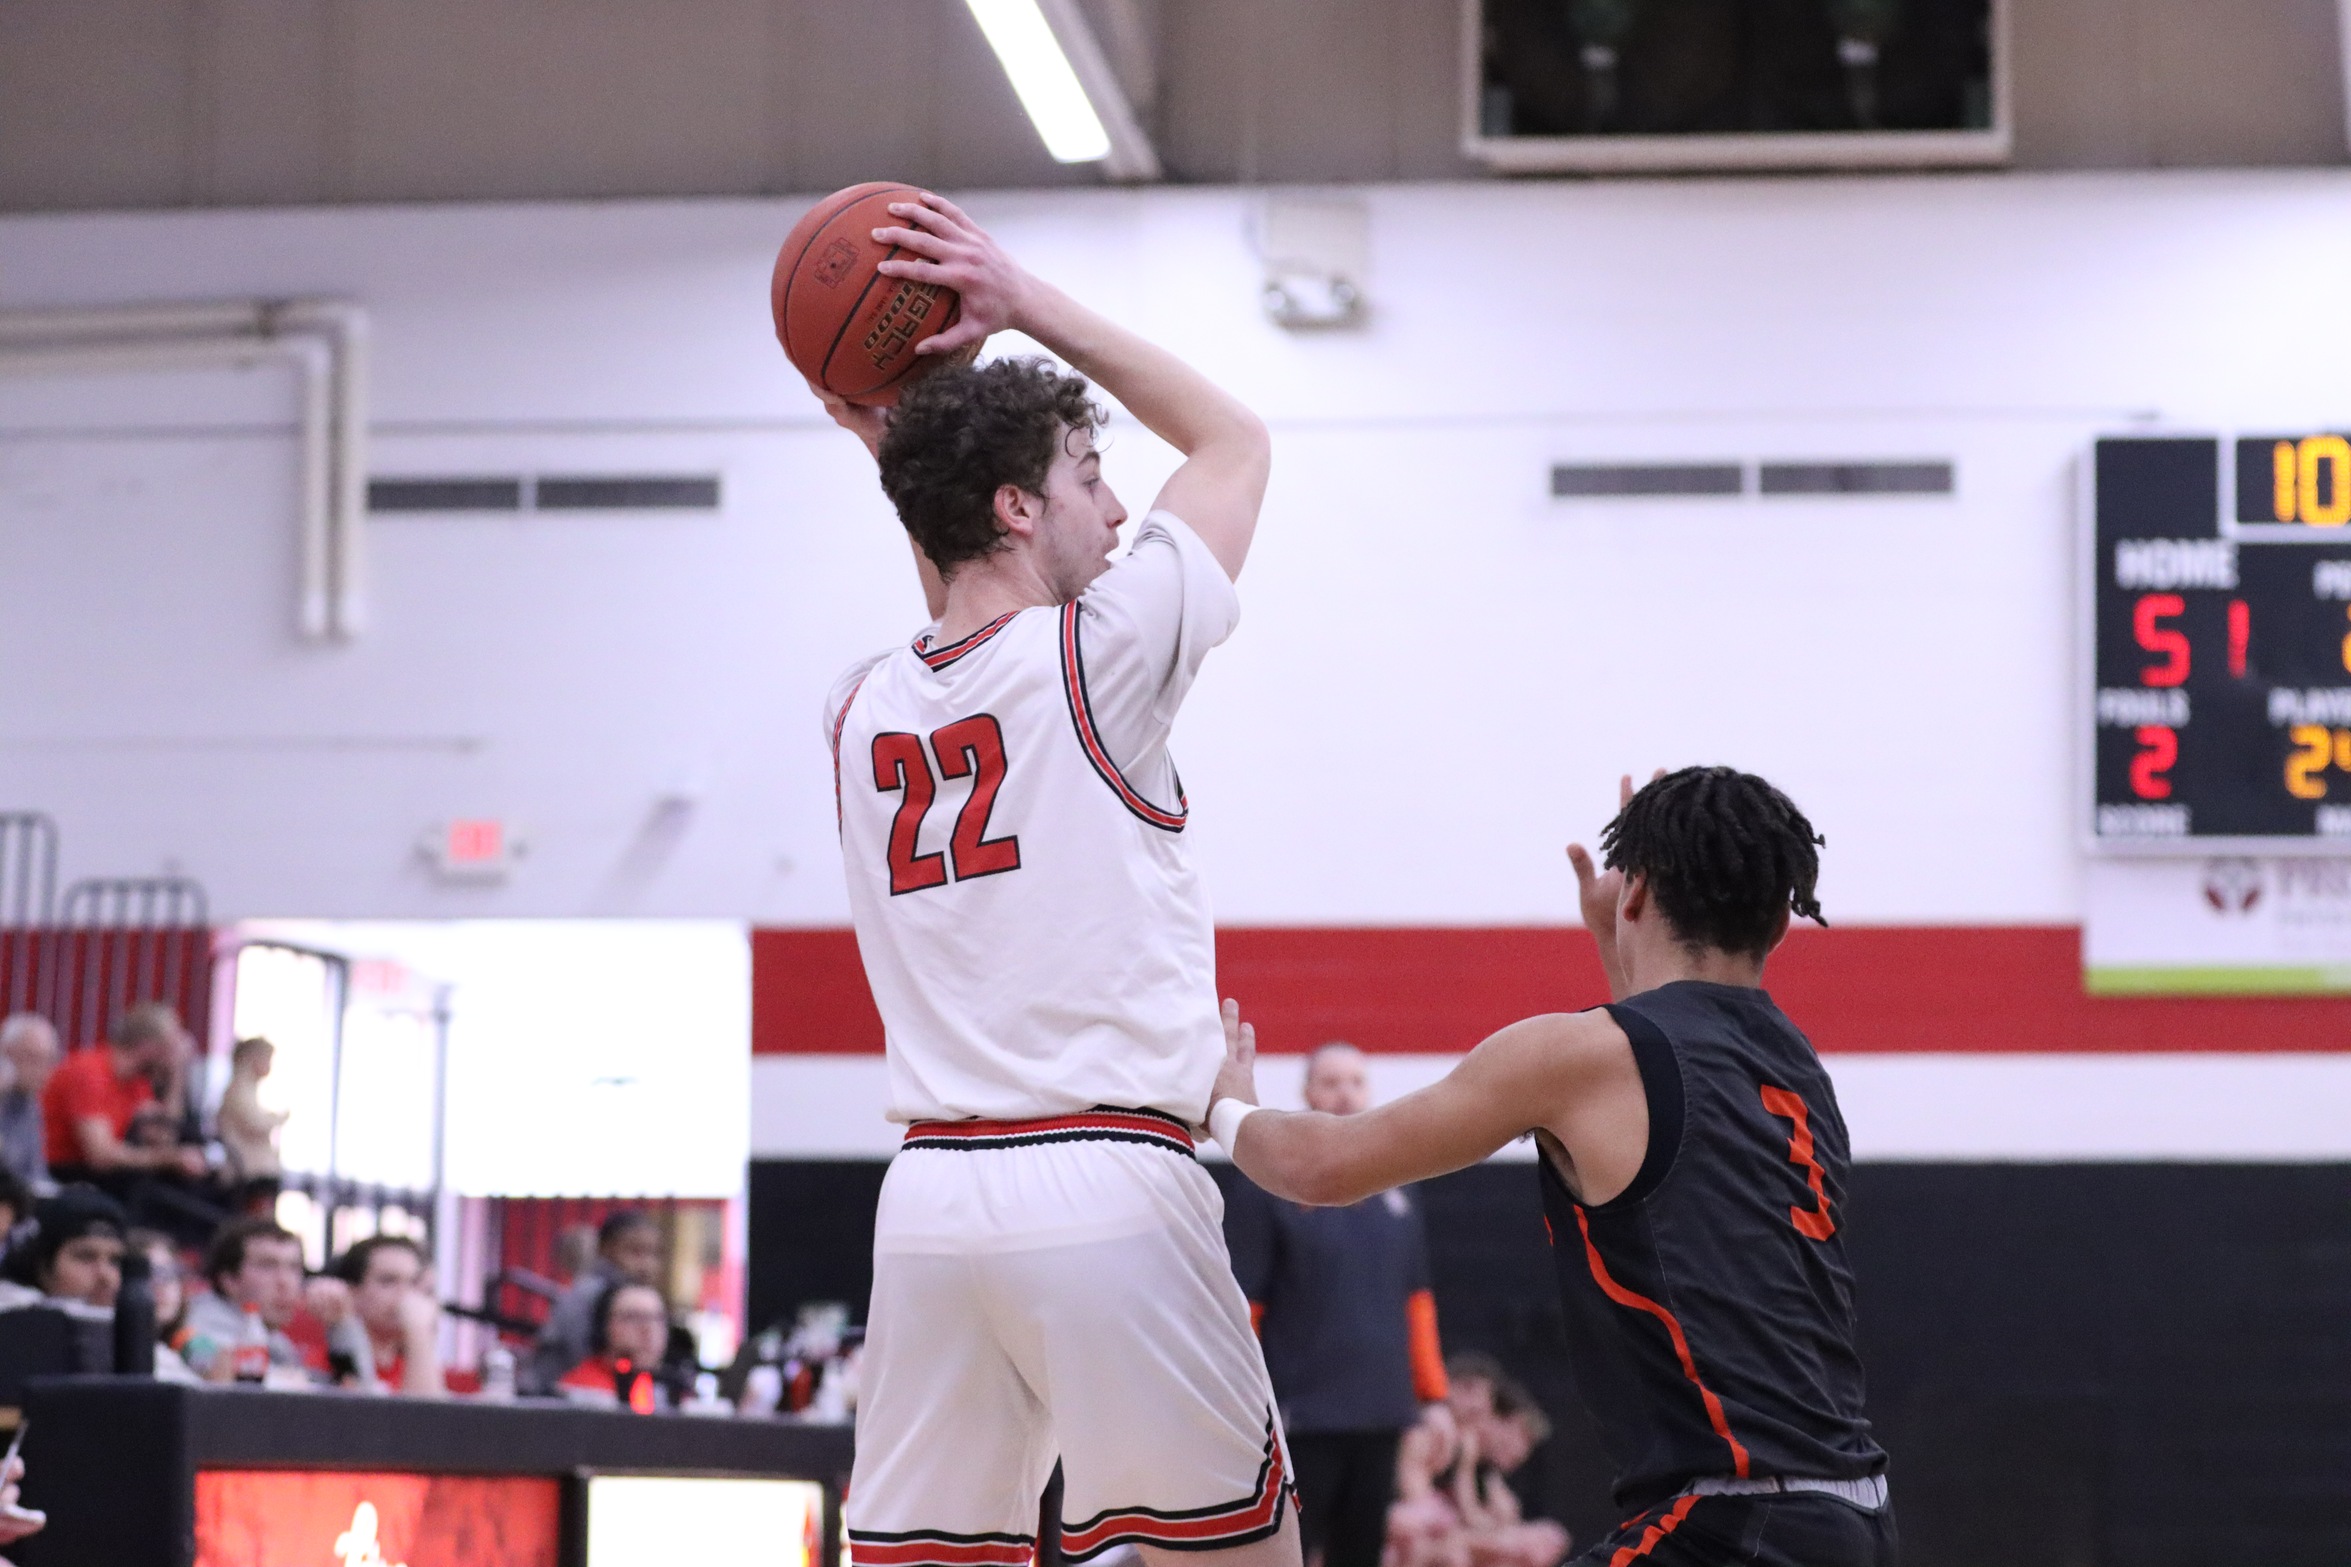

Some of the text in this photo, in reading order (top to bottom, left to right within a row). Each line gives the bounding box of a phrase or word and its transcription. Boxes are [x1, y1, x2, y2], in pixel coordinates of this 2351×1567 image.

[872, 282, 938, 371] EGACY
[871, 712, 1021, 897] 22
[2129, 724, 2179, 799] 2
[1760, 1084, 1836, 1242] 3
